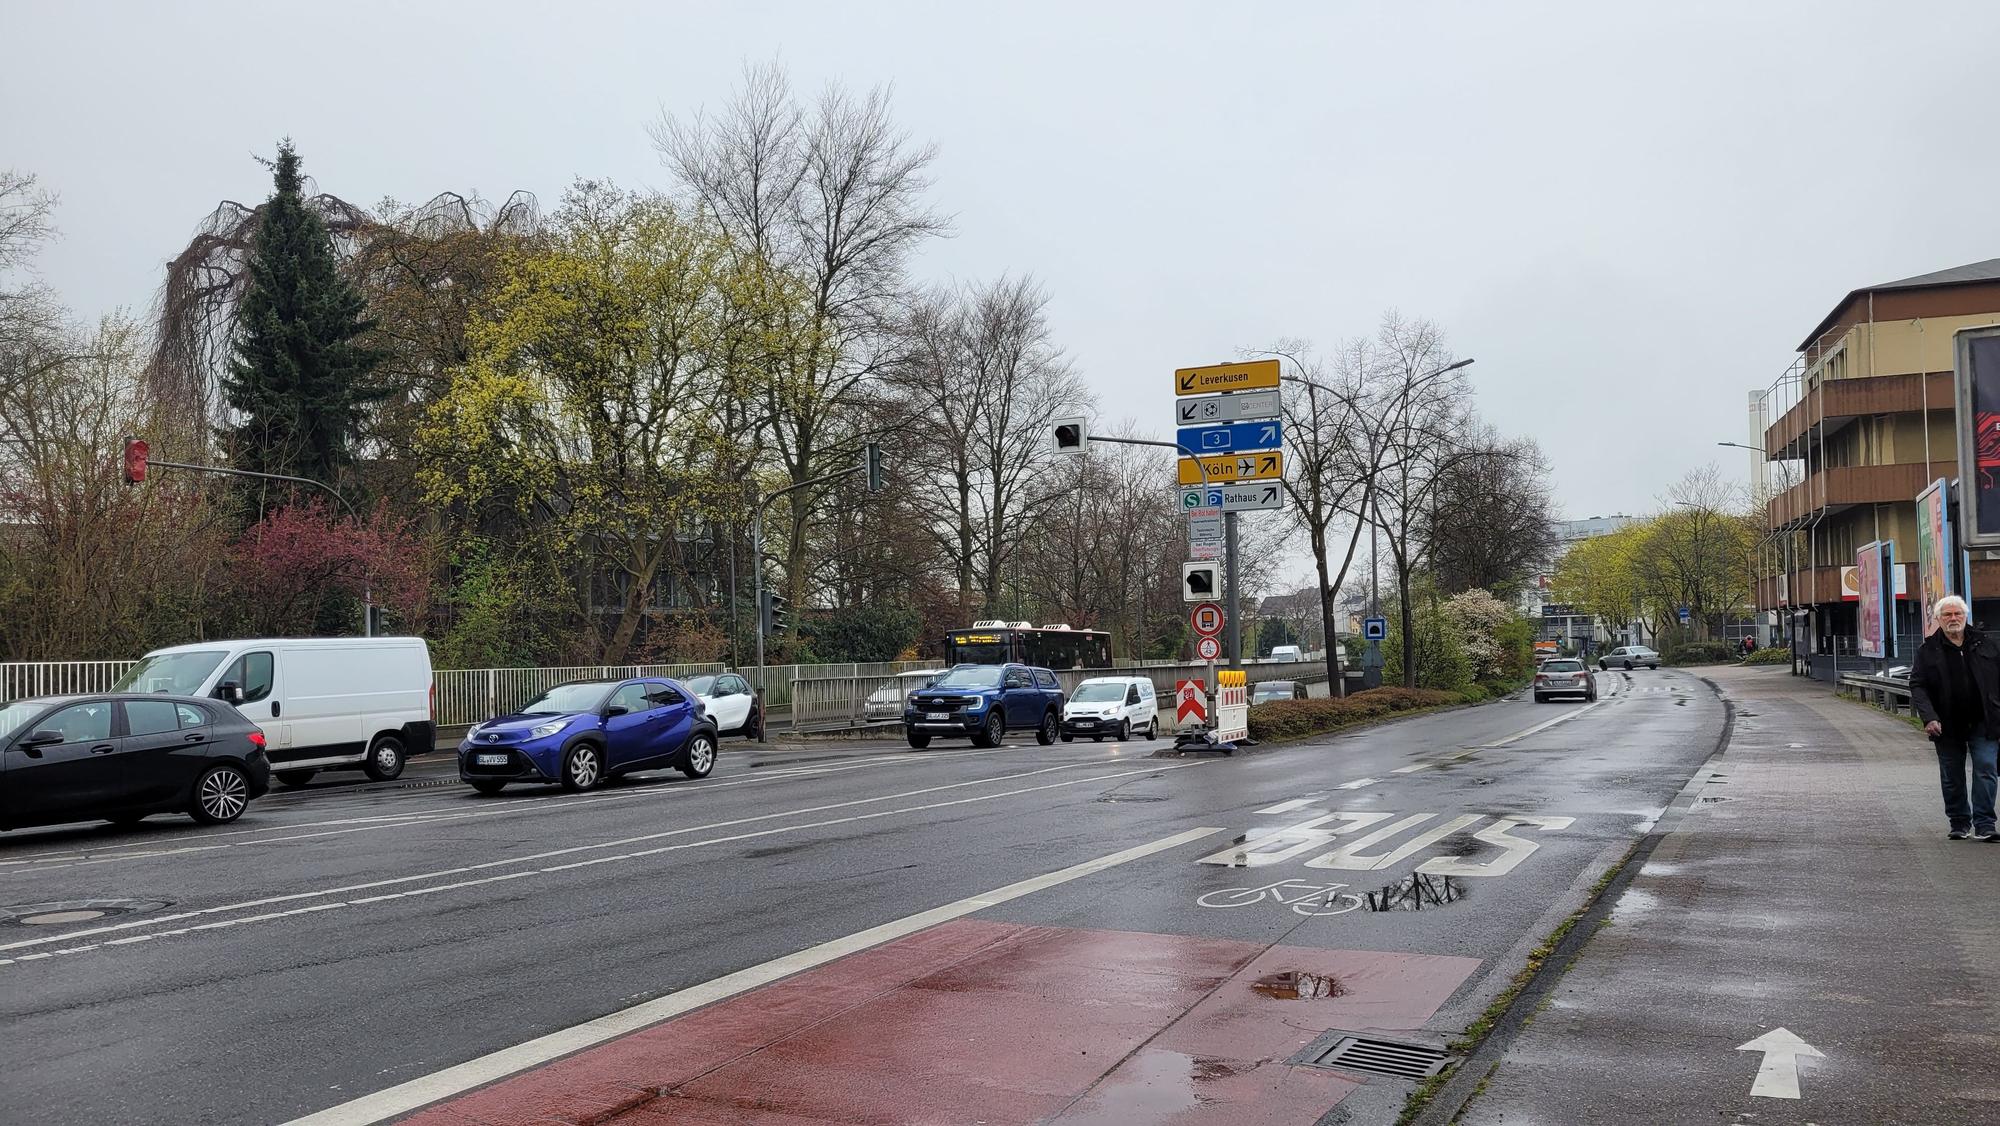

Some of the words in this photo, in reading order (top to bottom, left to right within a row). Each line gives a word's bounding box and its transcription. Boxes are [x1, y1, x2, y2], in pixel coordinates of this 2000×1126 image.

[1200, 373, 1249, 385] Leverkusen
[1214, 433, 1220, 445] 3
[1203, 463, 1233, 476] Köln
[1225, 493, 1257, 504] Rathaus
[1194, 812, 1577, 877] BUS
